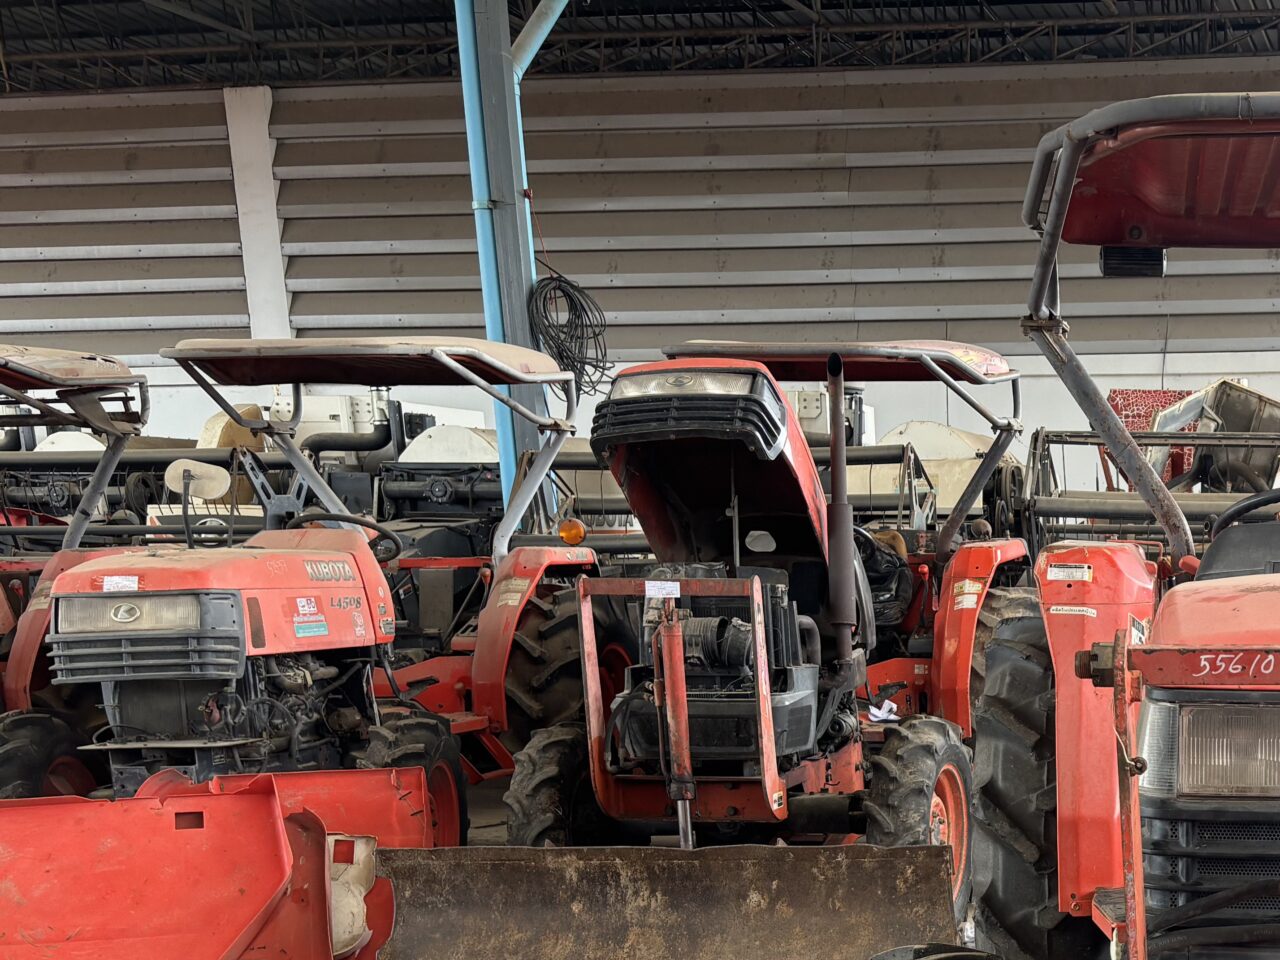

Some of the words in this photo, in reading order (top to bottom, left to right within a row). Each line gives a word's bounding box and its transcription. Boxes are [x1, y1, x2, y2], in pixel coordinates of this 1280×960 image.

[304, 561, 356, 580] KUBOTA
[330, 597, 362, 609] L4508
[1192, 653, 1275, 677] 55610
